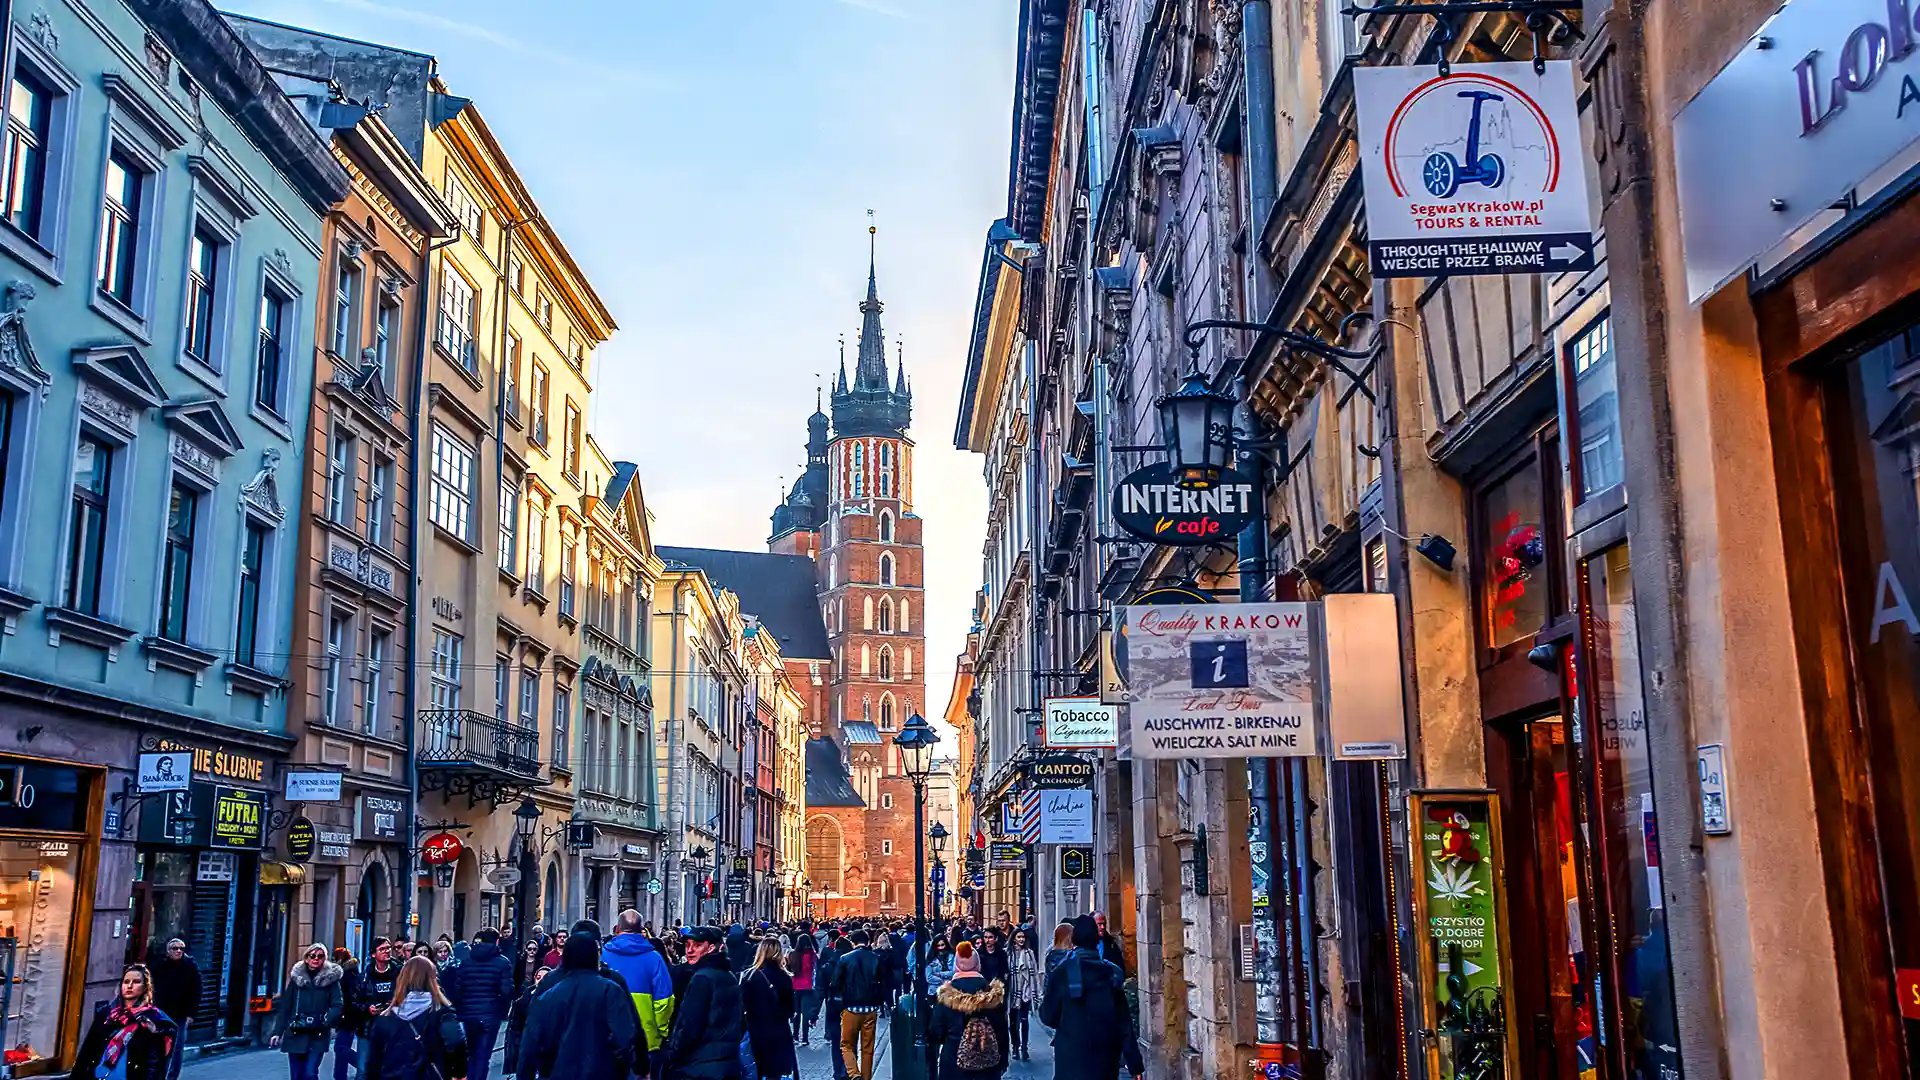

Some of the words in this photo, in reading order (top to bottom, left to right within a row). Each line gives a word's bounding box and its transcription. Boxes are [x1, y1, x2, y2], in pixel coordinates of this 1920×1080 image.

[1410, 200, 1544, 217] SegwaYKrakoW.pl
[1416, 217, 1465, 230] TOURS
[1469, 217, 1480, 228] &
[1485, 215, 1542, 227] RENTAL
[1380, 244, 1450, 258] THROUGH
[1449, 243, 1479, 255] THE
[1479, 241, 1543, 255] HALLWAY
[1381, 254, 1440, 270] WEJŚCIE
[1446, 255, 1490, 269] PRZEZ
[1495, 253, 1545, 268] BRAMĘ
[1177, 516, 1220, 537] cafe
[1138, 608, 1200, 640] Quality
[1204, 613, 1303, 631] KRAKOW
[1182, 693, 1225, 712] Local
[1226, 690, 1264, 712] Tours
[1051, 709, 1110, 723] Tobacco
[1144, 717, 1225, 732] AUSCHWITZ
[1234, 715, 1302, 730] BIRKENAU
[1053, 724, 1109, 740] Cigarettes
[1151, 735, 1225, 750] WIELICZKA
[1227, 735, 1257, 749] SALT
[1260, 734, 1297, 748] MINE
[213, 746, 264, 782] ŚLUBNE
[1034, 764, 1091, 775] KANTOR
[1041, 777, 1085, 785] EXCHANGE
[218, 801, 259, 824] FUTRA
[1446, 928, 1485, 937] DOBRE
